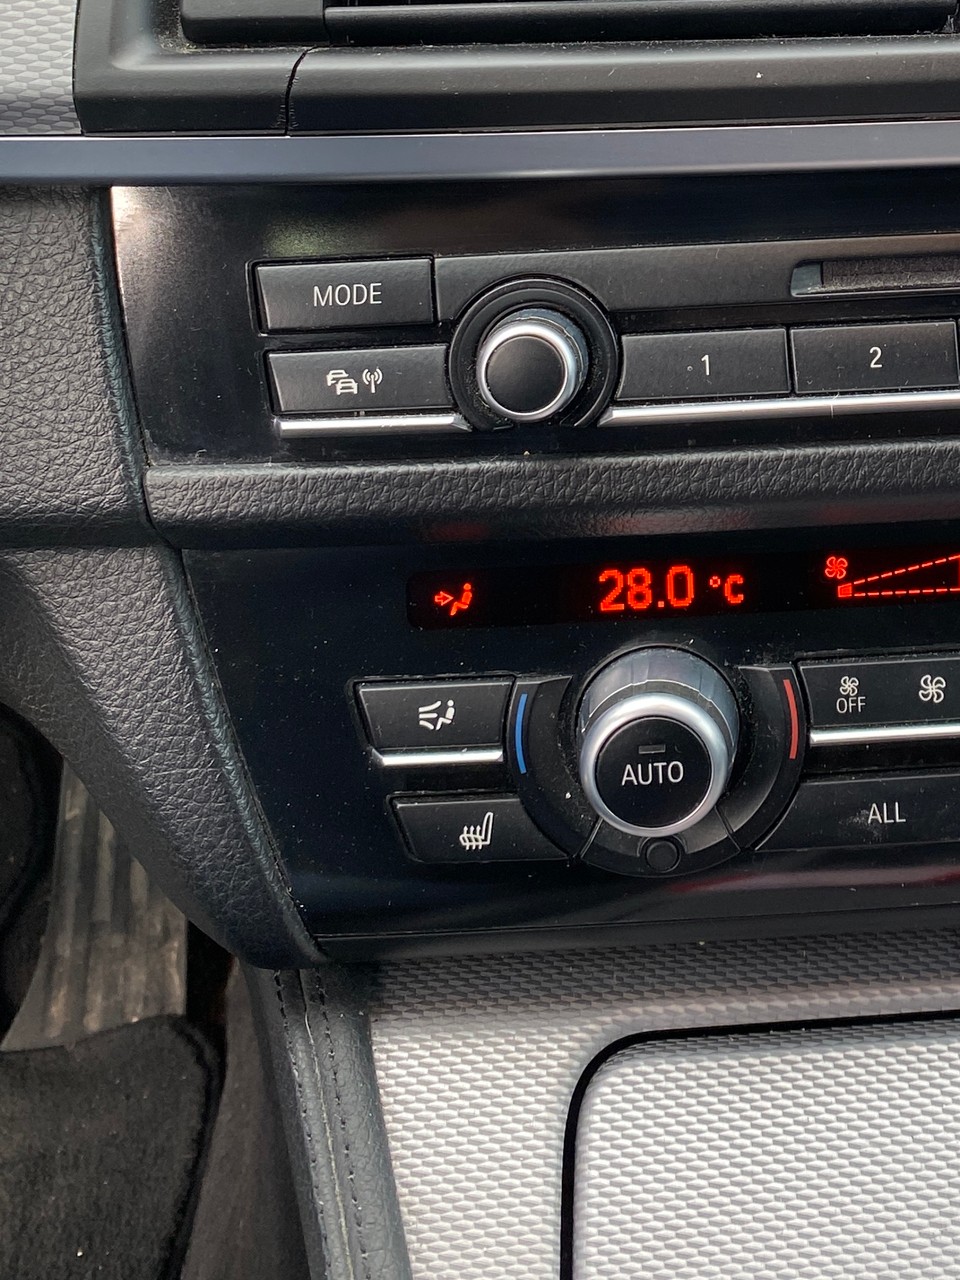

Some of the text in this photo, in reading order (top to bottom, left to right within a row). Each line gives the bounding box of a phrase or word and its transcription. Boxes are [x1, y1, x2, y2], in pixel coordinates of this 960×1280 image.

[312, 282, 383, 307] MODE
[701, 355, 711, 376] 1
[868, 346, 883, 369] 2
[598, 565, 695, 612] 28.0
[836, 694, 867, 715] OFF
[621, 761, 685, 787] AUTO
[867, 803, 906, 826] ALL
